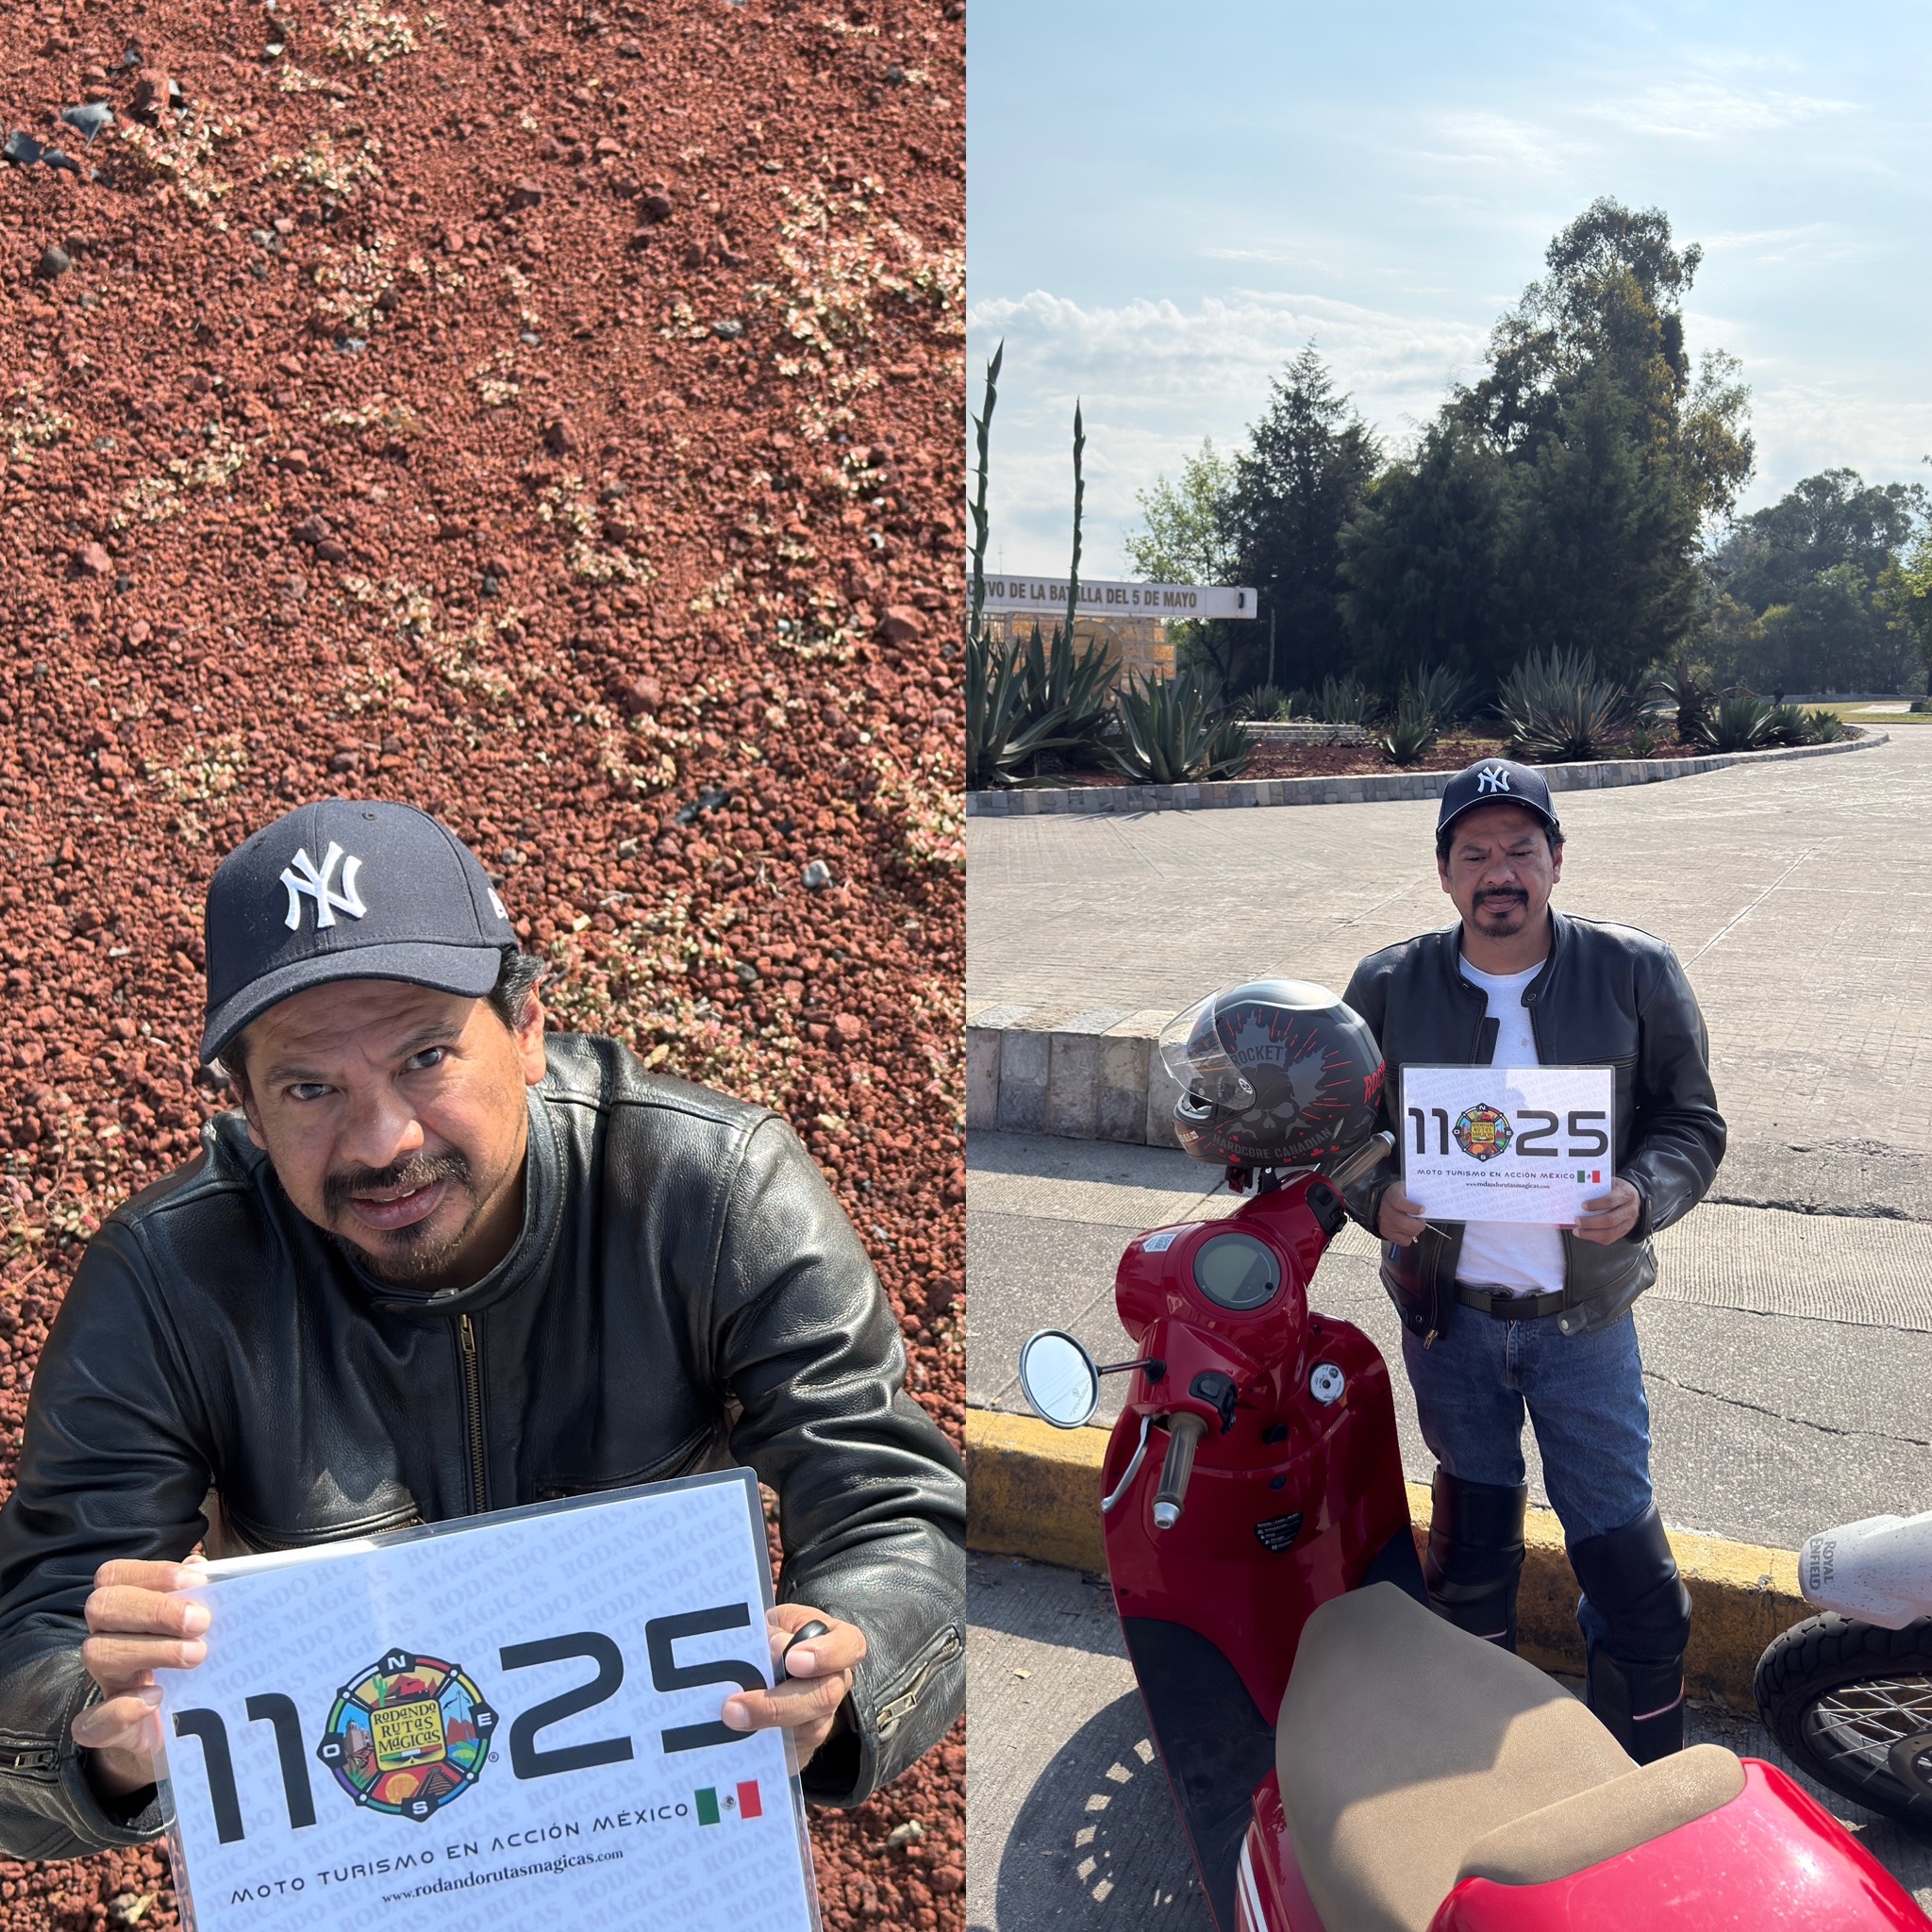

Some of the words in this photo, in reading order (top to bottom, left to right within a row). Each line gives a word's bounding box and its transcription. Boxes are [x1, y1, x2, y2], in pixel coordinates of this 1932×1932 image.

[1009, 582, 1026, 599] DE
[1030, 583, 1045, 600] LA
[1107, 588, 1129, 605] DEL
[1132, 590, 1140, 606] 5
[1144, 591, 1159, 606] DE
[1163, 591, 1197, 608] MAYO
[1477, 766, 1510, 792] NY
[279, 841, 367, 931] NY
[1213, 1134, 1272, 1159] HARDCORE
[1274, 1124, 1334, 1158] CANADIAN
[1516, 1110, 1608, 1157] 25
[558, 1505, 681, 1582] RODANDO
[1809, 1538, 1824, 1591] ENFIELD
[1823, 1541, 1837, 1584] ROYAL
[426, 1541, 551, 1619] RODANDO
[452, 1591, 575, 1666] RODANDO
[575, 1550, 653, 1603] RUTAS
[209, 1621, 338, 1700] RODANDO
[388, 1655, 407, 1670] N
[477, 1713, 492, 1726] E
[324, 1743, 341, 1757] O
[412, 1802, 428, 1814] S
[230, 1877, 305, 1905] MOTO
[318, 1850, 435, 1886] TURISMO
[446, 1840, 479, 1860] EN
[491, 1823, 580, 1852] ACCIÓN
[592, 1803, 689, 1833] MÉXICO
[382, 1850, 624, 1904] www.rodandorutasmagicas.com
